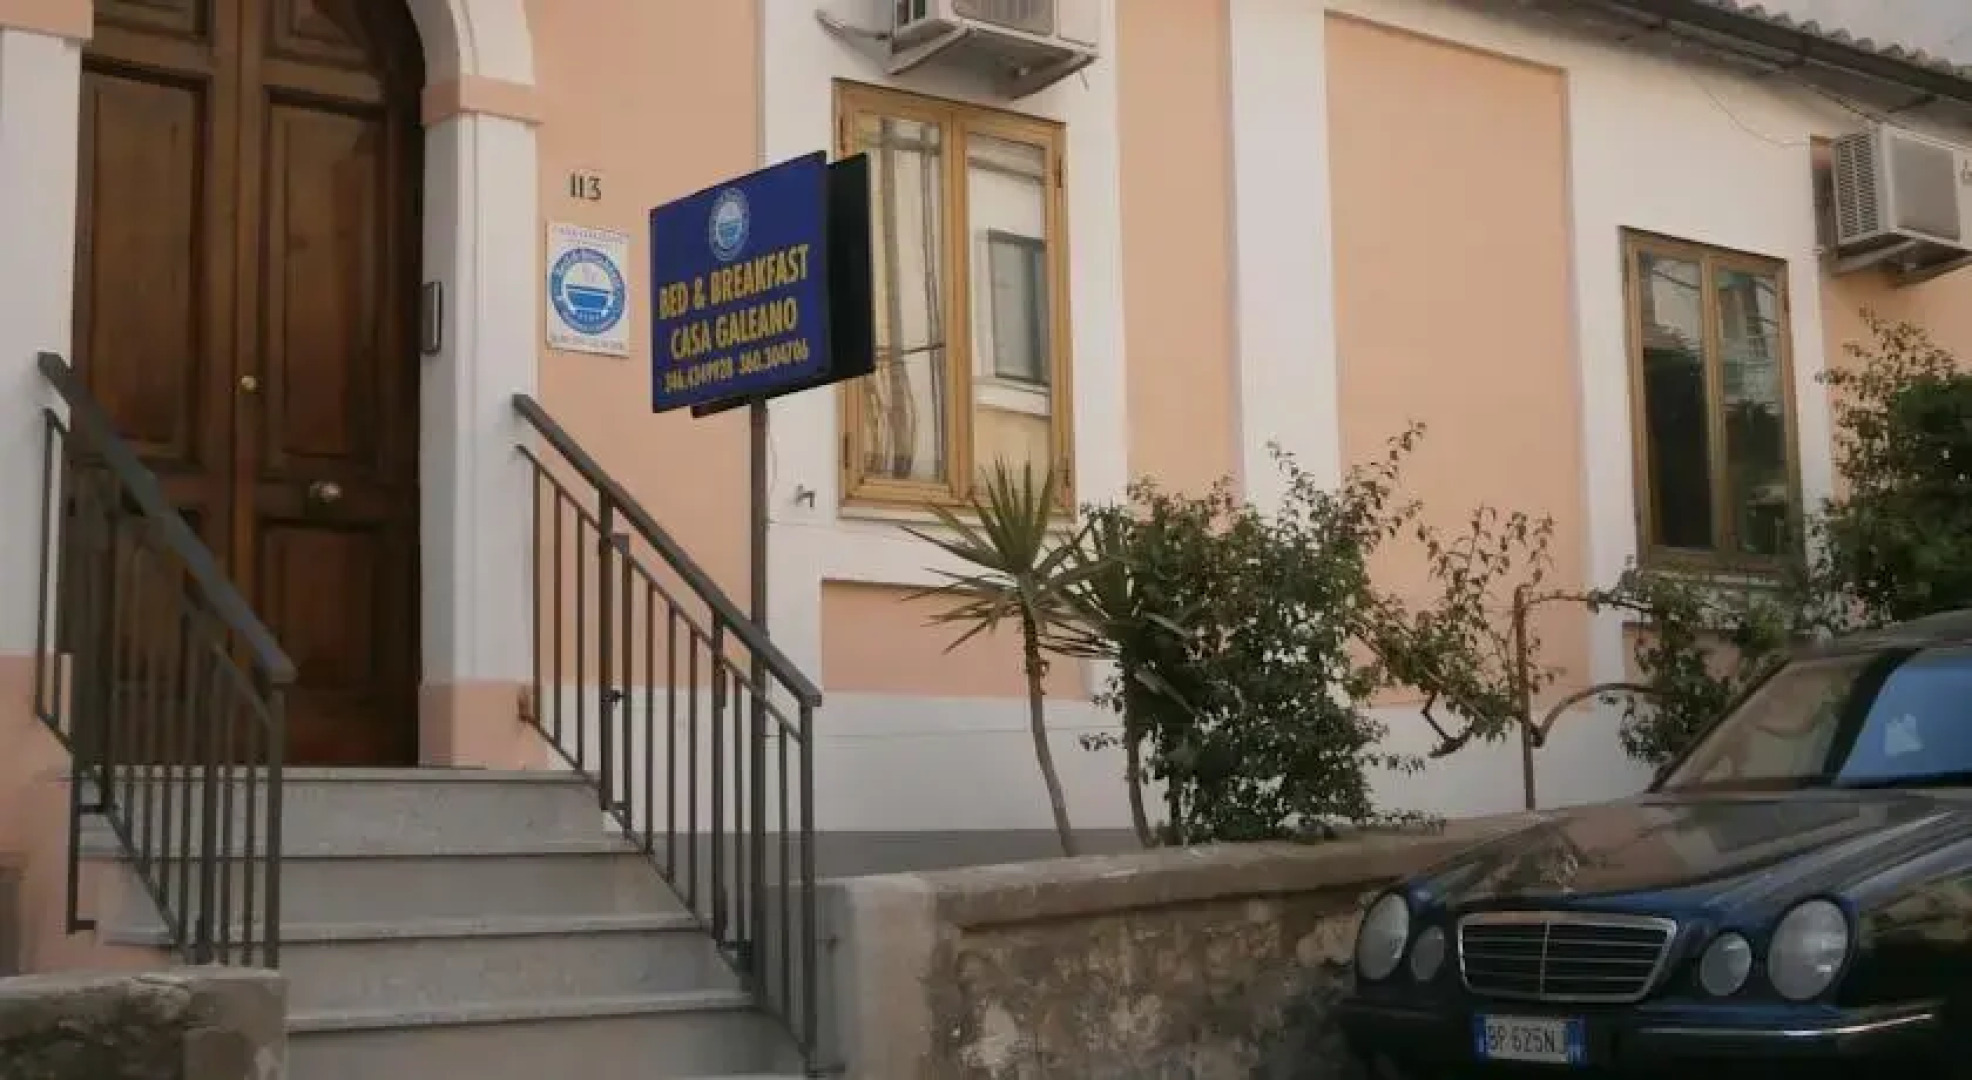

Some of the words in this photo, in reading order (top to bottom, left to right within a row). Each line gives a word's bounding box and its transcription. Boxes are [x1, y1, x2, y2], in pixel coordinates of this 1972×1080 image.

[570, 172, 602, 200] 113
[660, 282, 689, 319] BED
[695, 277, 705, 309] &
[711, 244, 808, 304] BREAKFAST
[672, 320, 711, 359] CASA
[717, 298, 798, 347] GALEANO
